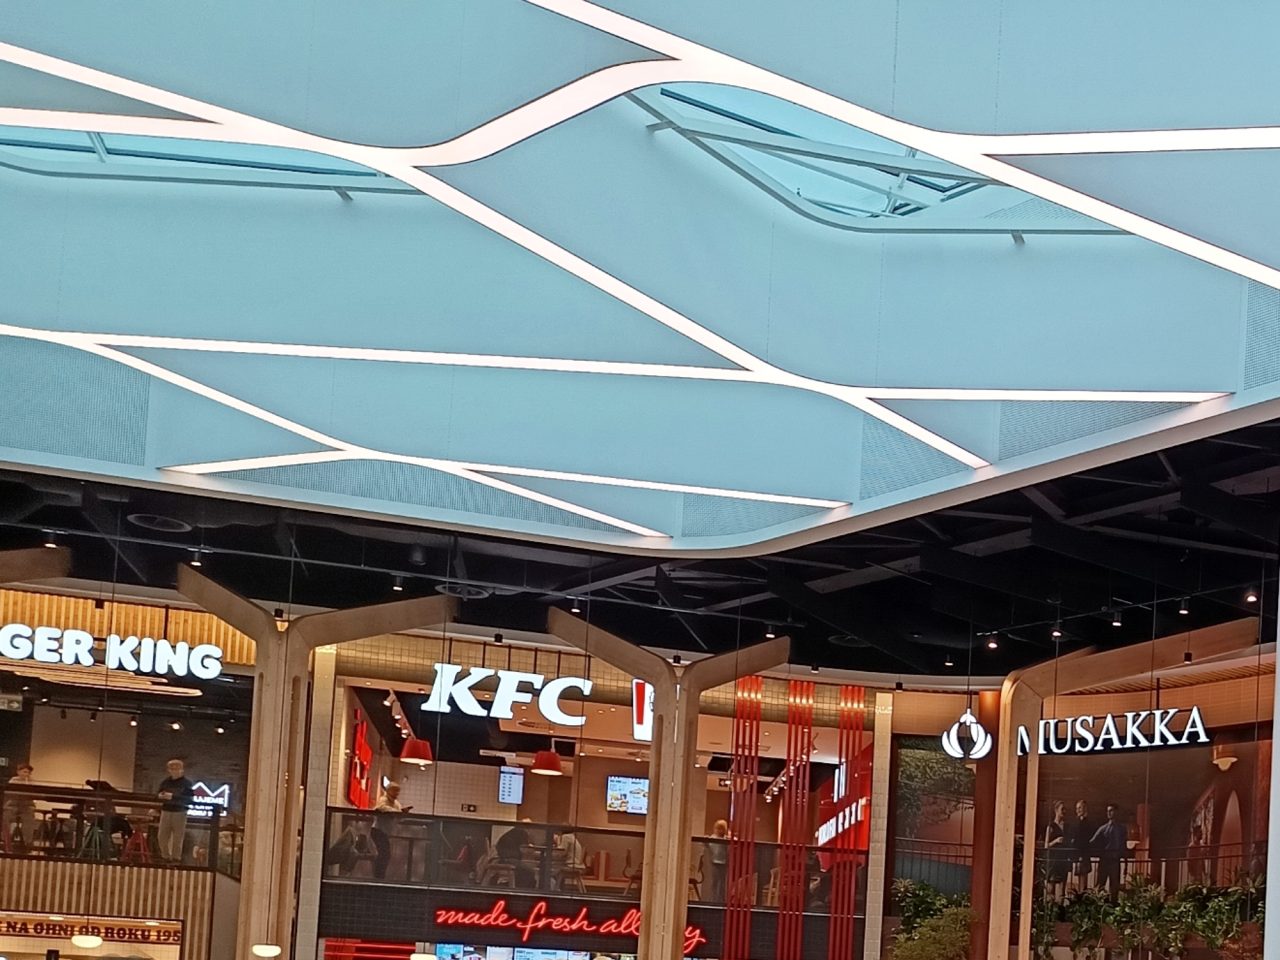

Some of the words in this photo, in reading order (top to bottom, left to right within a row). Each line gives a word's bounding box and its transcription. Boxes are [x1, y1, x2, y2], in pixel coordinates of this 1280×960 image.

[106, 633, 223, 680] KING
[421, 663, 593, 726] KFC
[6, 920, 29, 934] NA
[104, 927, 151, 941] ROKU
[436, 900, 517, 928] made
[516, 901, 597, 942] fresh
[600, 909, 642, 936] all
